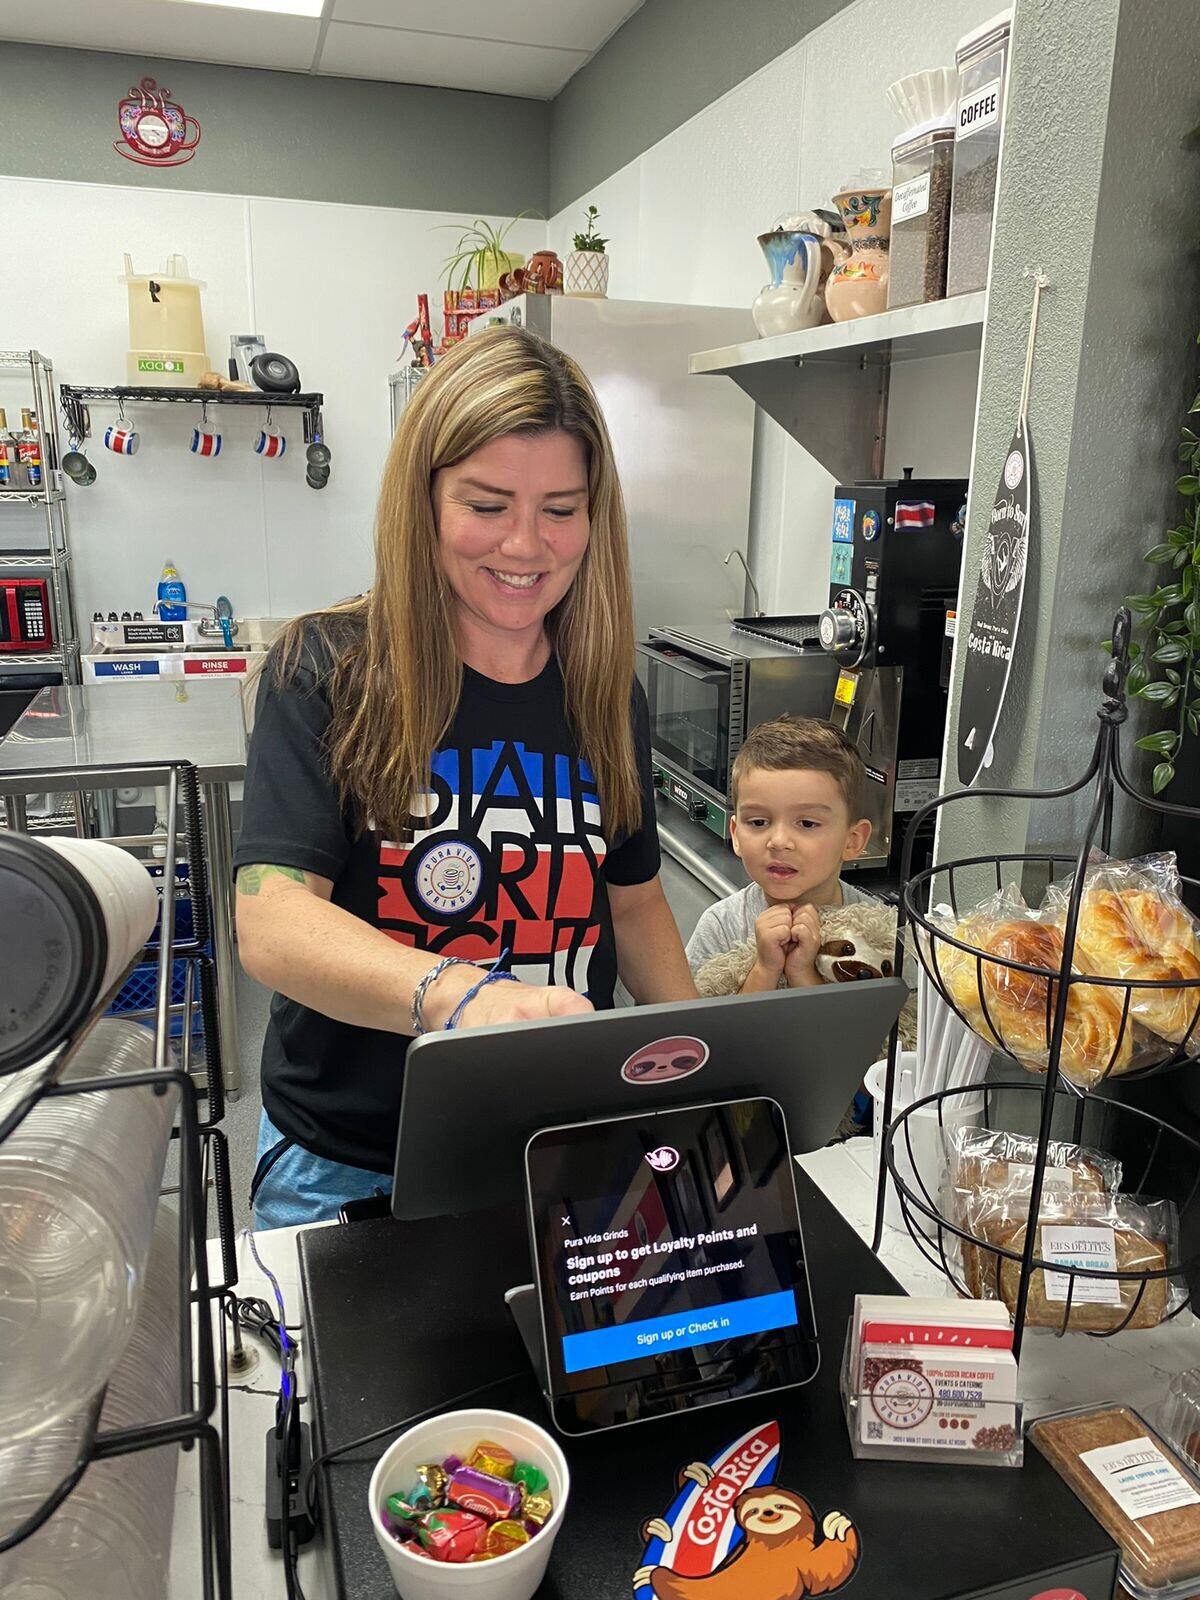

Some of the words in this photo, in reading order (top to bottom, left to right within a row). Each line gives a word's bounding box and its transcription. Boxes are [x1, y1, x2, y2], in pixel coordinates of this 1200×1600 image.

[960, 93, 996, 126] COFFEE
[902, 200, 918, 214] Coffee
[968, 632, 992, 655] Costa
[992, 640, 1012, 661] Rica
[425, 848, 452, 870] PURA
[456, 848, 476, 870] VIDA
[564, 1237, 582, 1248] Pura
[584, 1233, 602, 1245] Vida
[602, 1228, 629, 1242] Grinds
[566, 1254, 595, 1271] Sign
[597, 1252, 614, 1266] up
[615, 1249, 628, 1261] to
[631, 1244, 651, 1260] get
[652, 1235, 696, 1255] Loyalty
[698, 1227, 735, 1246] Points
[736, 1224, 758, 1238] and
[1072, 1242, 1111, 1252] DELITES
[1055, 1258, 1084, 1267] BANANA
[568, 1265, 621, 1286] coupons
[570, 1290, 589, 1302] Earn
[590, 1284, 614, 1298] Points
[615, 1282, 628, 1292] for
[628, 1277, 648, 1290] each
[649, 1270, 686, 1288] qualifying
[704, 1259, 745, 1277] purchased.
[636, 1332, 659, 1346] Sign
[661, 1330, 674, 1342] up
[676, 1327, 686, 1337] or
[688, 1318, 719, 1336] Check
[720, 1316, 730, 1328] in
[880, 1374, 902, 1390] PURA
[907, 1374, 926, 1392] VIDA
[977, 1372, 994, 1380] COFFEE
[686, 1483, 736, 1546] Costa
[718, 1439, 769, 1486] Rica
